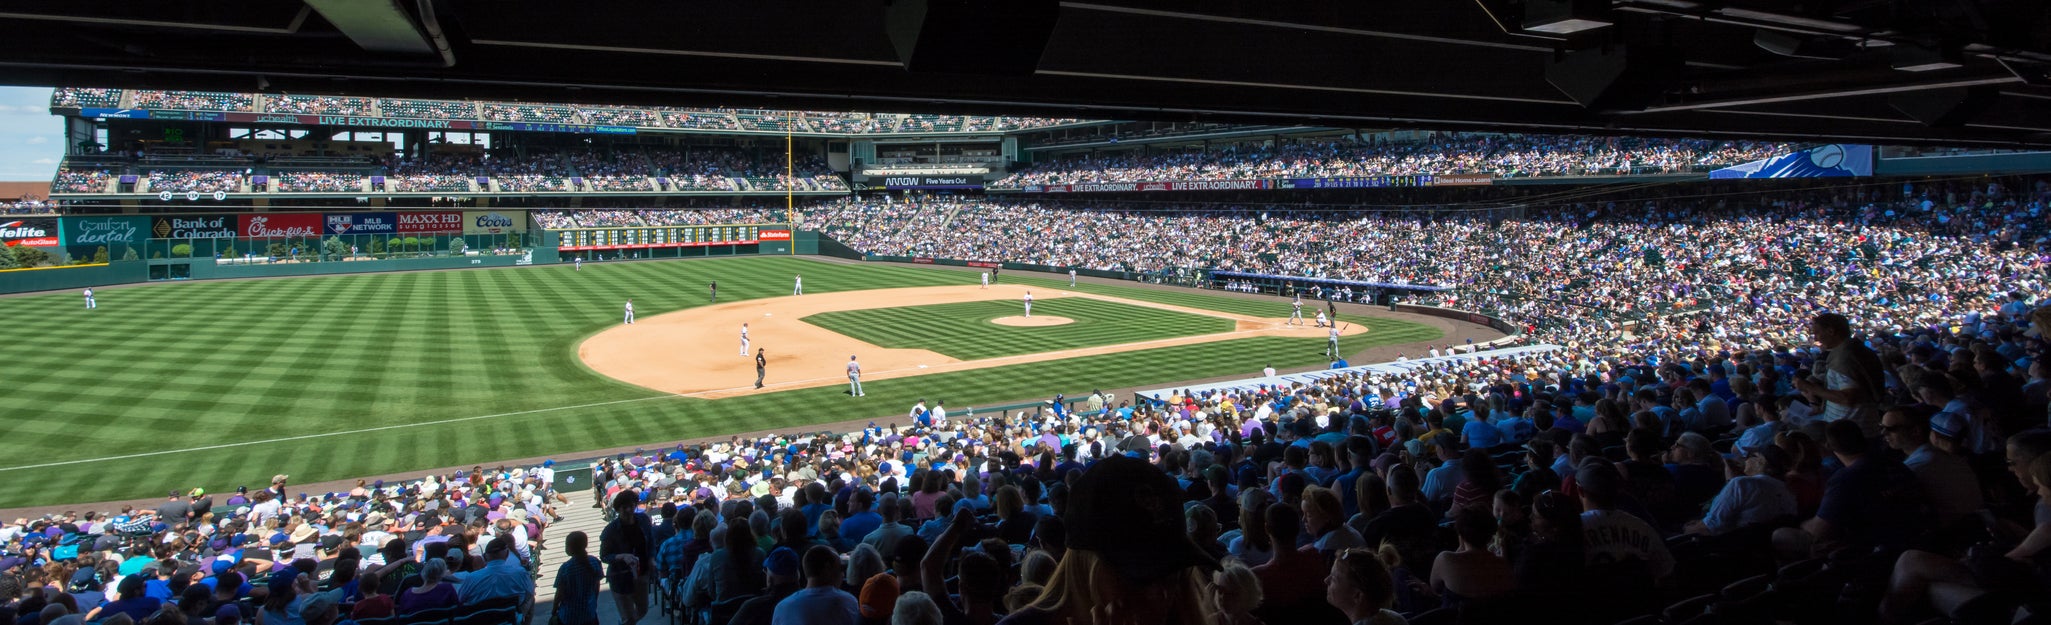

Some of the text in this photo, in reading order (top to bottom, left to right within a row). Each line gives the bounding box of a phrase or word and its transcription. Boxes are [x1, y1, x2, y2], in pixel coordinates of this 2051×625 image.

[257, 114, 298, 123] uchealth
[319, 116, 451, 129] LIVE EXTRAORDINARY.
[885, 177, 919, 186] ARROW
[1172, 180, 1258, 190] LIVE EXTRAORDINARY.
[1072, 183, 1138, 192] LIVE EXTRAORDINARY.
[173, 217, 224, 229] Bank of
[329, 215, 351, 223] MLB
[400, 214, 461, 224] MAXX HD
[476, 215, 513, 228] Coors
[79, 218, 130, 231] Comfort
[76, 226, 136, 244] dental
[173, 228, 236, 239] Colorado
